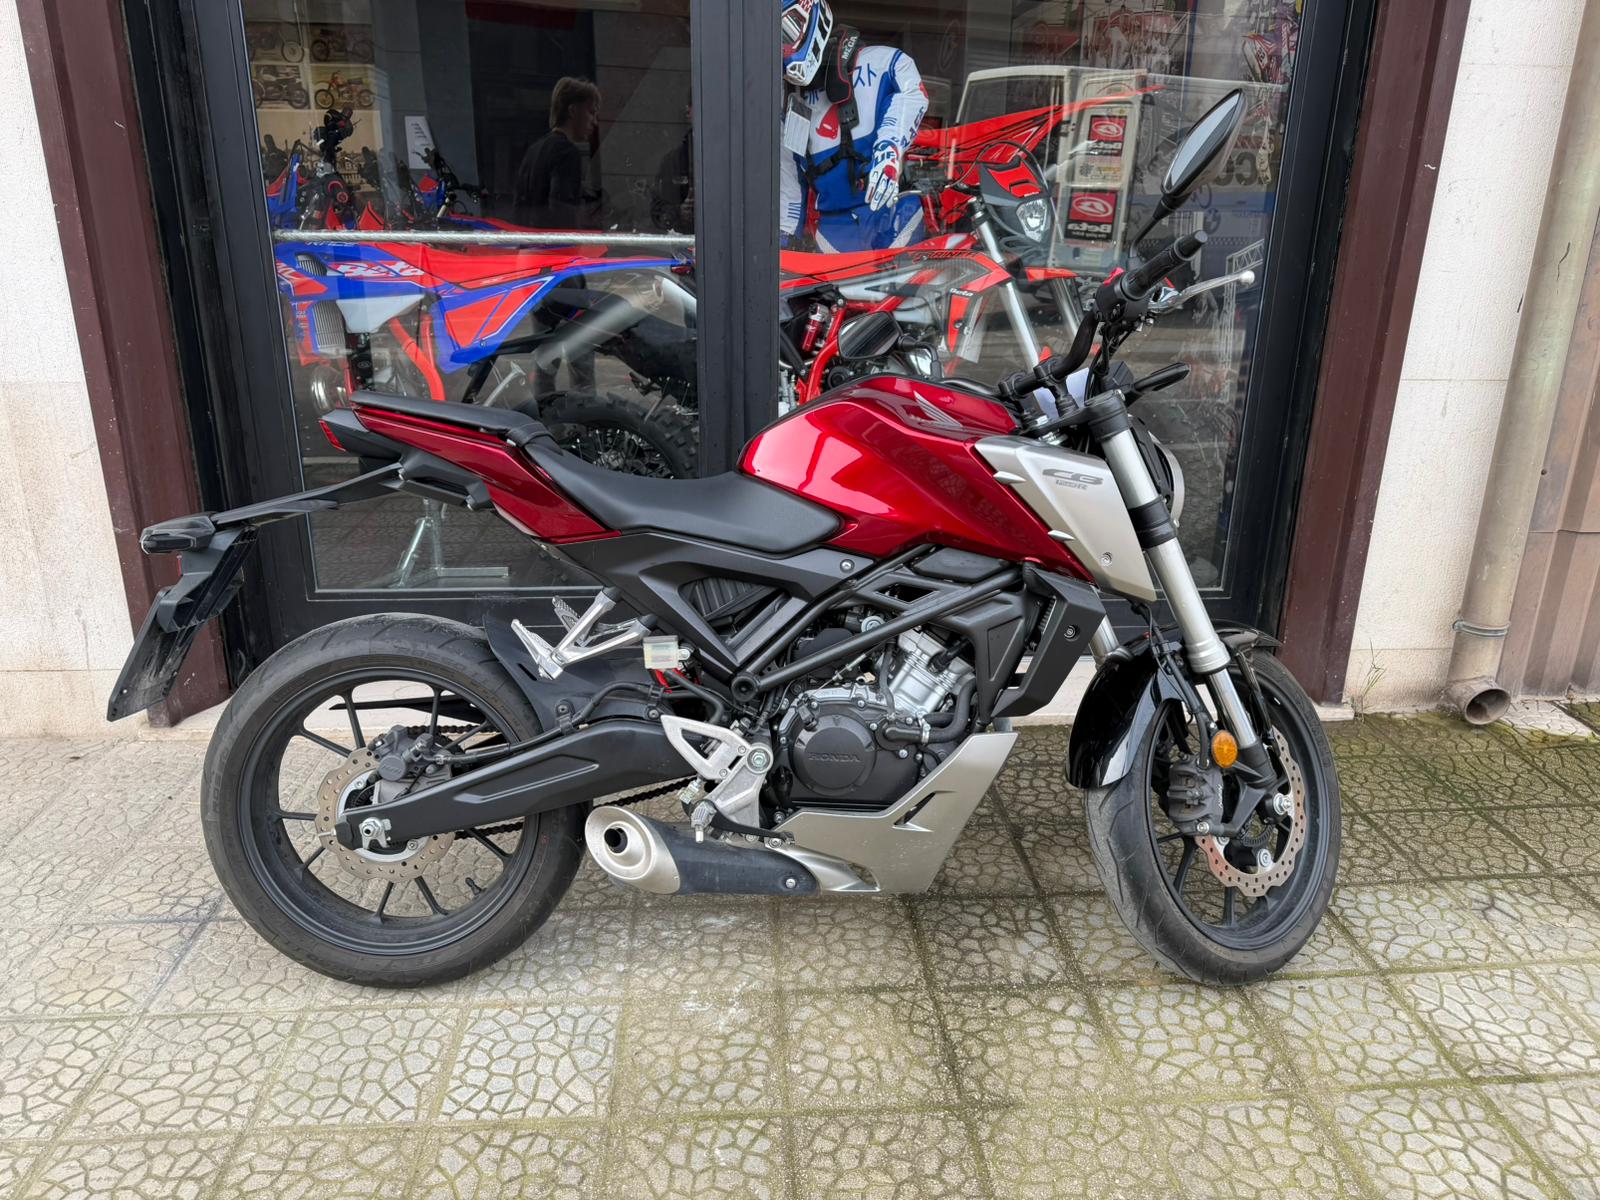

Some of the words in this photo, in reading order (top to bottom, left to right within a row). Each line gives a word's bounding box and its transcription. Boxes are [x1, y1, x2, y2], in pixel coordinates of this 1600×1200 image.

[949, 287, 974, 297] Beta
[1042, 468, 1104, 486] CB
[808, 752, 861, 763] HONDA
